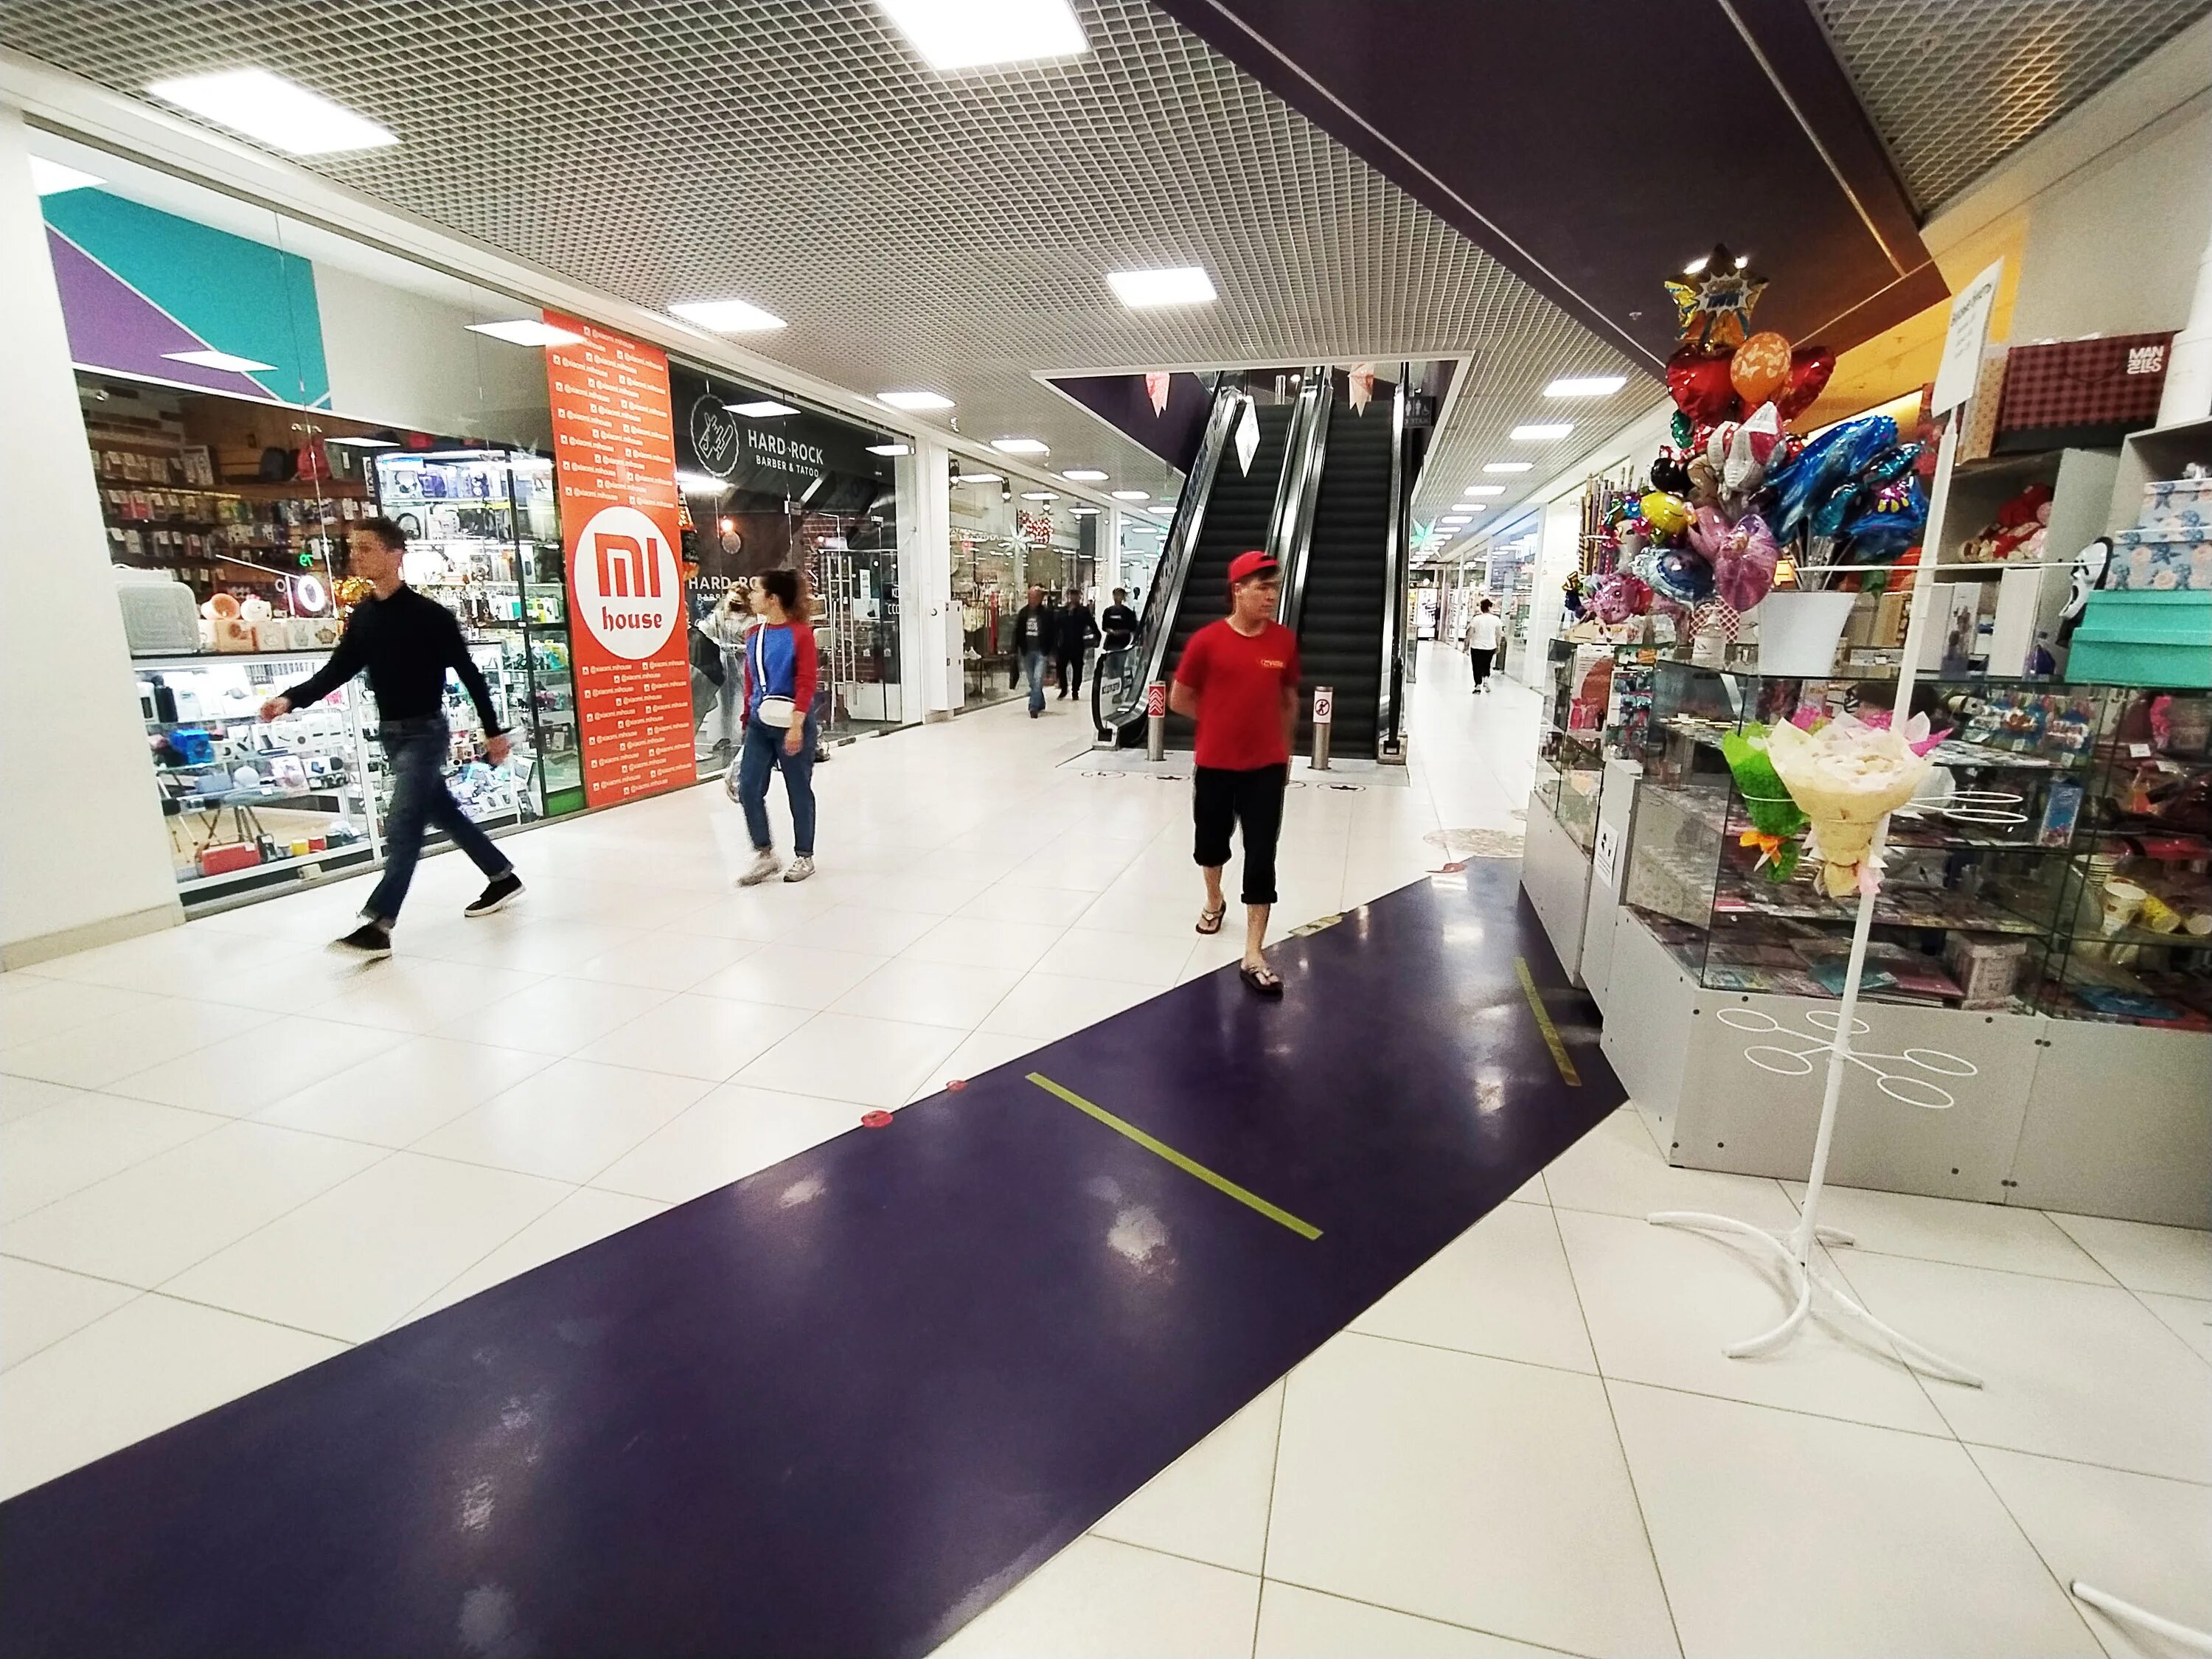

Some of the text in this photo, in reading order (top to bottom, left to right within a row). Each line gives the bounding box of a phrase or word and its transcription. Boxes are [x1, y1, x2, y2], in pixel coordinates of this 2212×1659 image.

[2129, 346, 2165, 360] MAN
[756, 454, 819, 478] BARBER & TATOO
[602, 606, 662, 631] house
